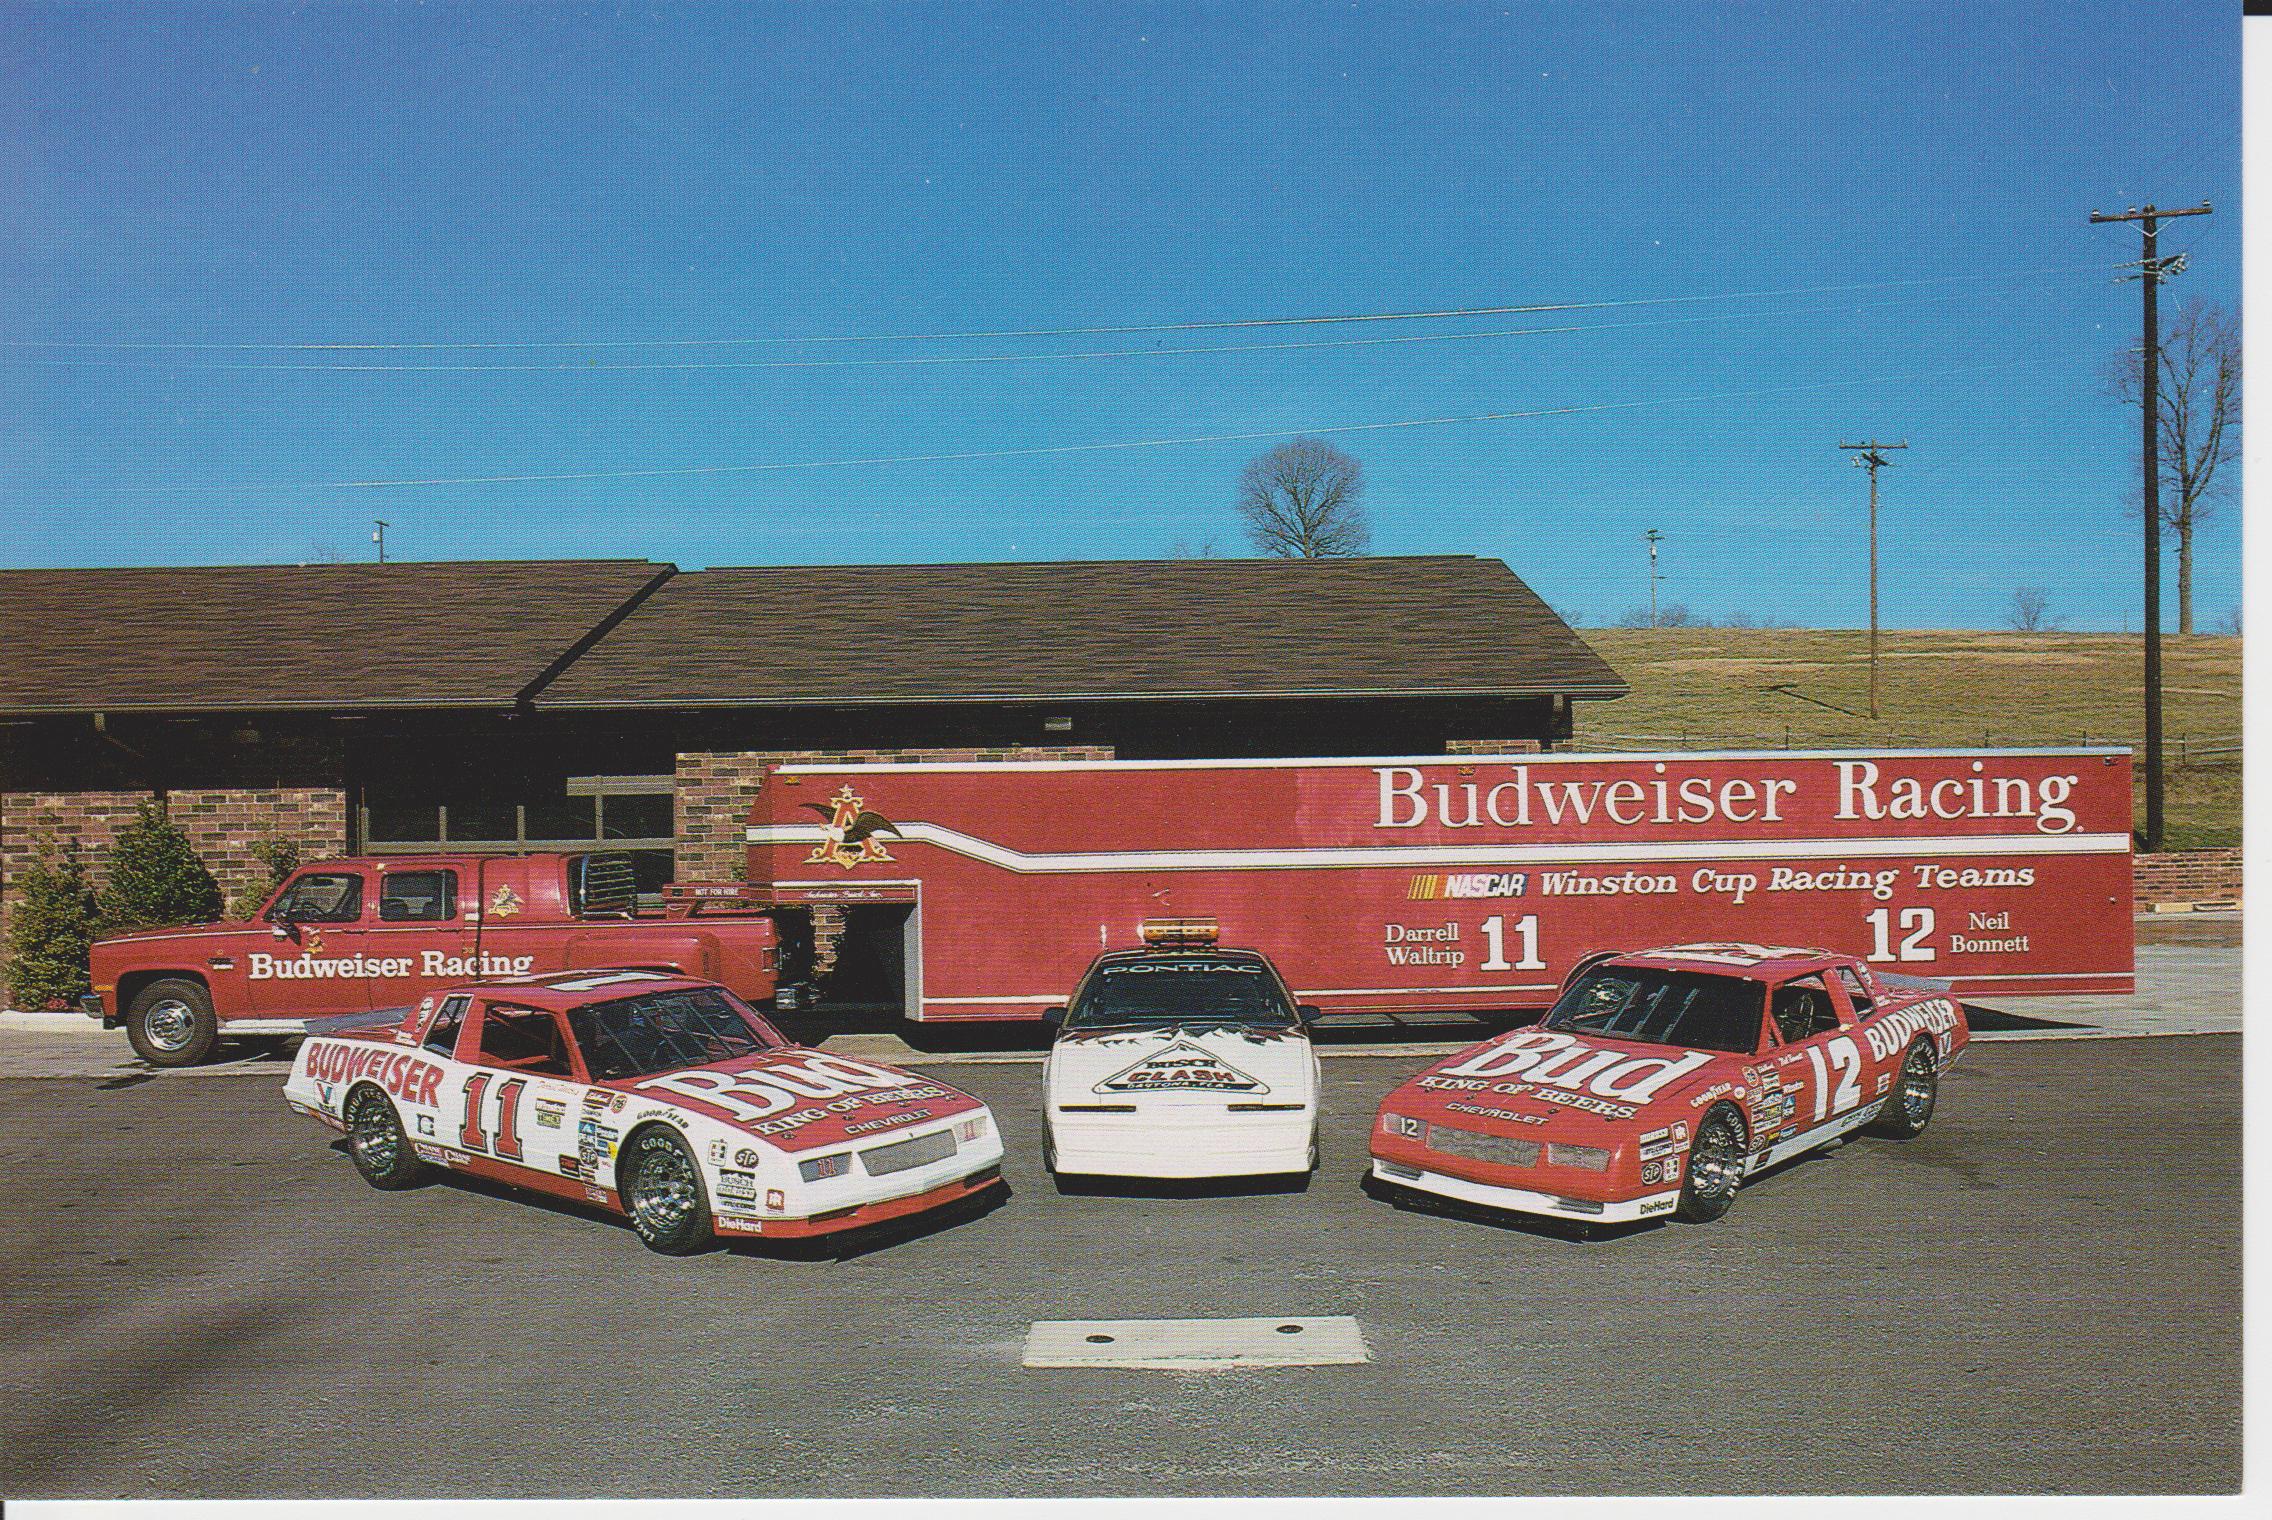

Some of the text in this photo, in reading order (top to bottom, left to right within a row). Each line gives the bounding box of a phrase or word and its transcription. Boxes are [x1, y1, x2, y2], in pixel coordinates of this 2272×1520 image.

[1373, 762, 1797, 829] Budweiser
[695, 887, 738, 897] NOT FOR HIRE
[1444, 864, 2036, 905] NASCAR Winston Cup Racing Teams
[1969, 911, 2010, 930] Neil
[1385, 922, 1460, 943] Darrell
[1480, 914, 1547, 971] 11
[1866, 907, 1936, 962] 12
[1949, 934, 2029, 953] Bonnett
[248, 952, 413, 980] Budweiser
[419, 950, 533, 976] Racing
[1385, 945, 1465, 968] Waltrip
[1102, 963, 1262, 975] PONTIAC
[1863, 998, 1959, 1062] BUDWEISER
[305, 1042, 445, 1109] BUDWEISER
[1127, 1069, 1236, 1082] CLASH
[1145, 1059, 1217, 1069] BUSCH
[1436, 1032, 1718, 1104] Bud
[633, 1049, 926, 1123] Bud
[1416, 1076, 1493, 1092] KING
[1493, 1081, 1536, 1096] OF
[1806, 1035, 1863, 1123] 12
[459, 1071, 527, 1162] 11
[750, 1108, 829, 1136] KING
[826, 1096, 864, 1113] OF
[845, 1108, 933, 1135] CHEVROLET
[1446, 1103, 1549, 1126] CHEVROLET
[1399, 1116, 1418, 1137] 12
[736, 1149, 758, 1167] STP
[818, 1156, 836, 1177] 11
[1643, 1164, 1661, 1181] STP
[1639, 1197, 1674, 1215] DieHard
[718, 1216, 762, 1233] DieHard
